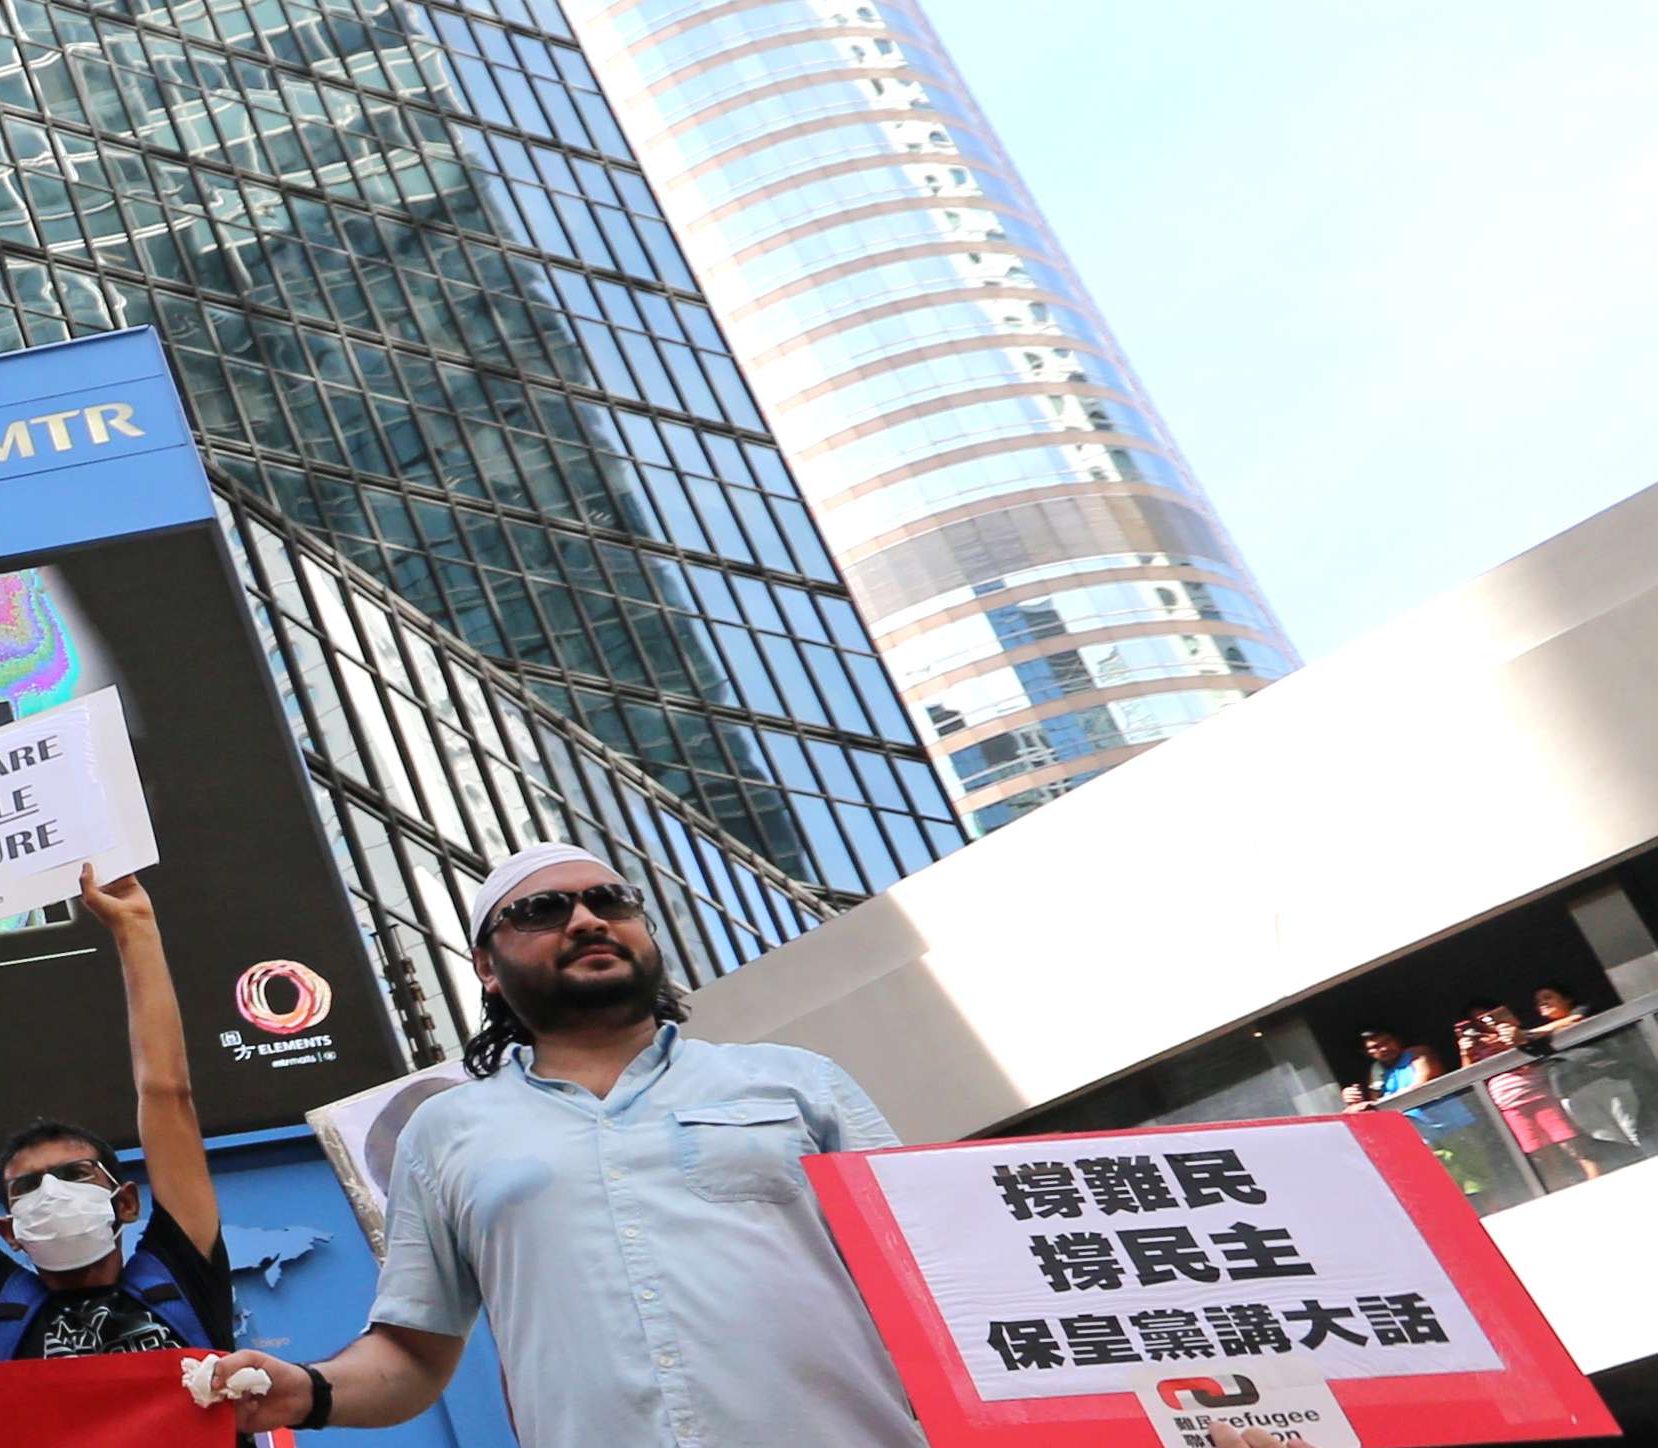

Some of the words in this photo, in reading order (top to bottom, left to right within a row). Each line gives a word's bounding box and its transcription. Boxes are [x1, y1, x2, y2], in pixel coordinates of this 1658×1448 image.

[257, 1035, 332, 1056] ELEMENTS
[992, 1149, 1267, 1221] 撐難民
[1029, 1220, 1318, 1294] 撐民主
[986, 1292, 1450, 1371] 保皇黨講大話
